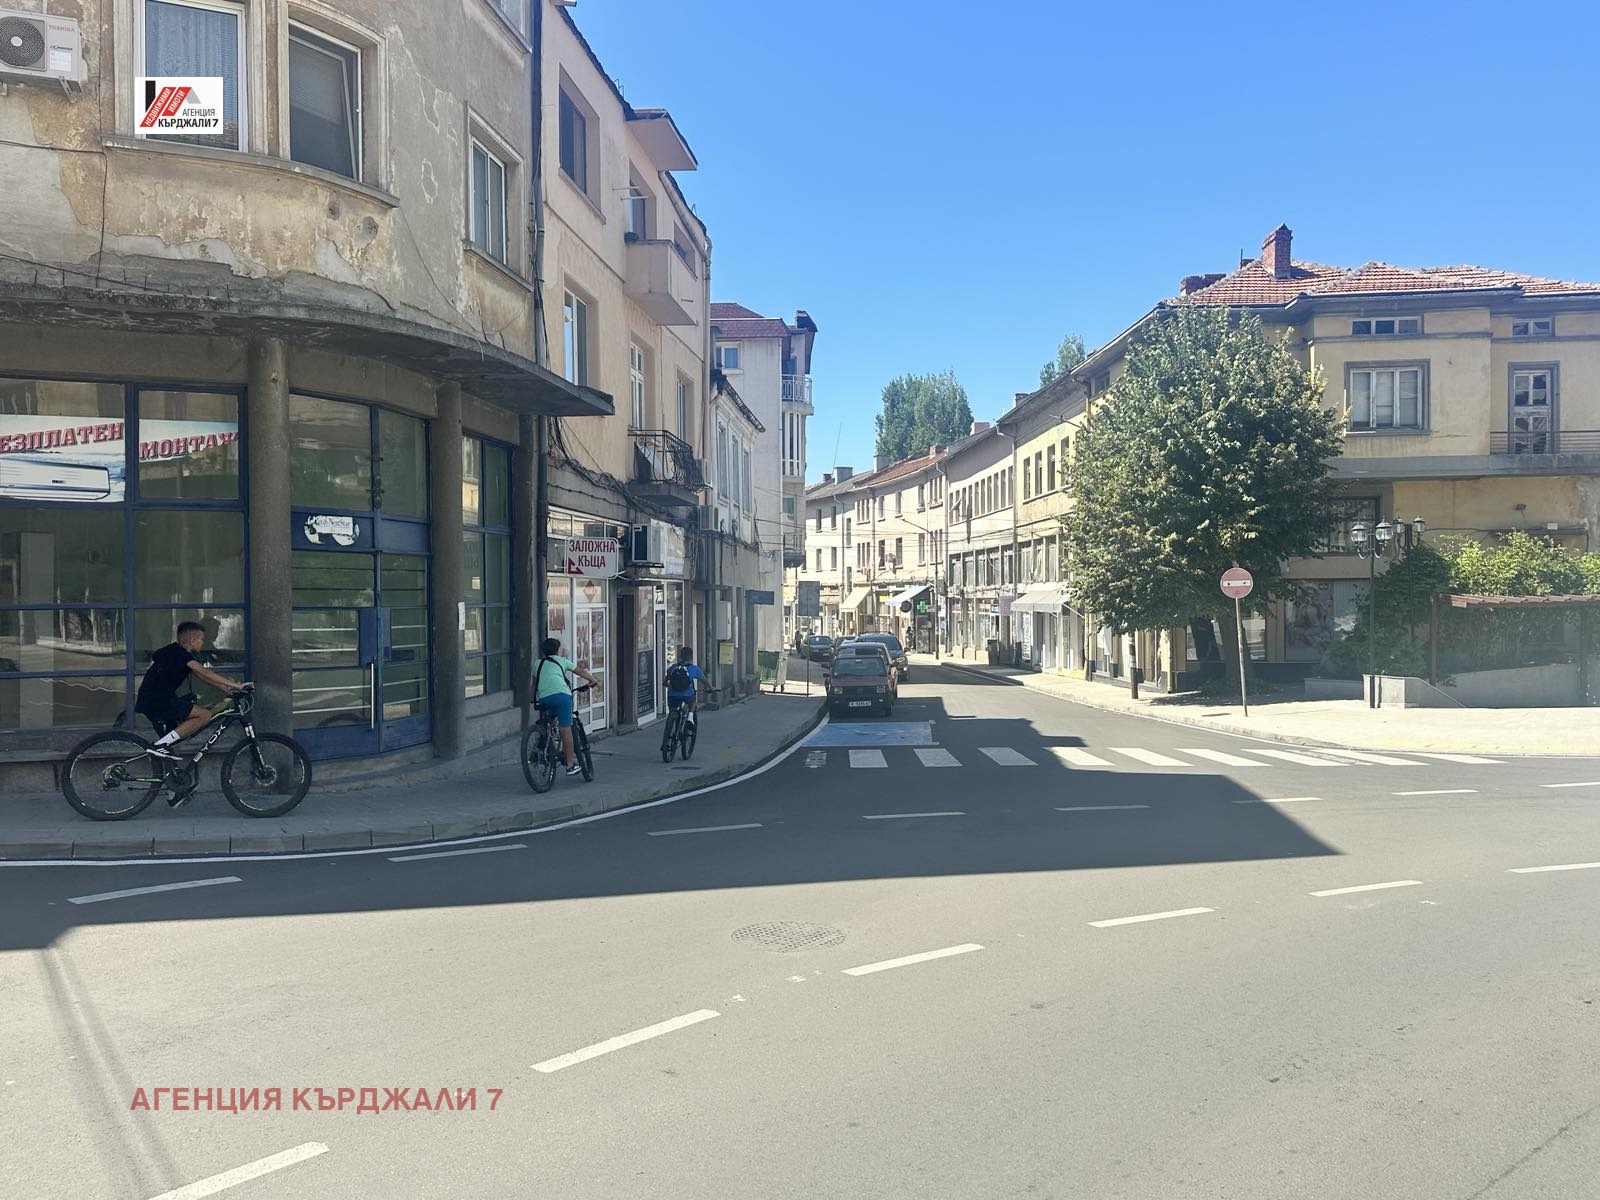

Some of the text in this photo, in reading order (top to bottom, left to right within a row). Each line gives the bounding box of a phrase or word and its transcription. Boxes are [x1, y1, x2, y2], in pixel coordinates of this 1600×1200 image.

[139, 431, 238, 460] МОНТАЖ
[569, 540, 616, 553] ЗАЛОЖНА
[578, 555, 606, 569] КЪЩА
